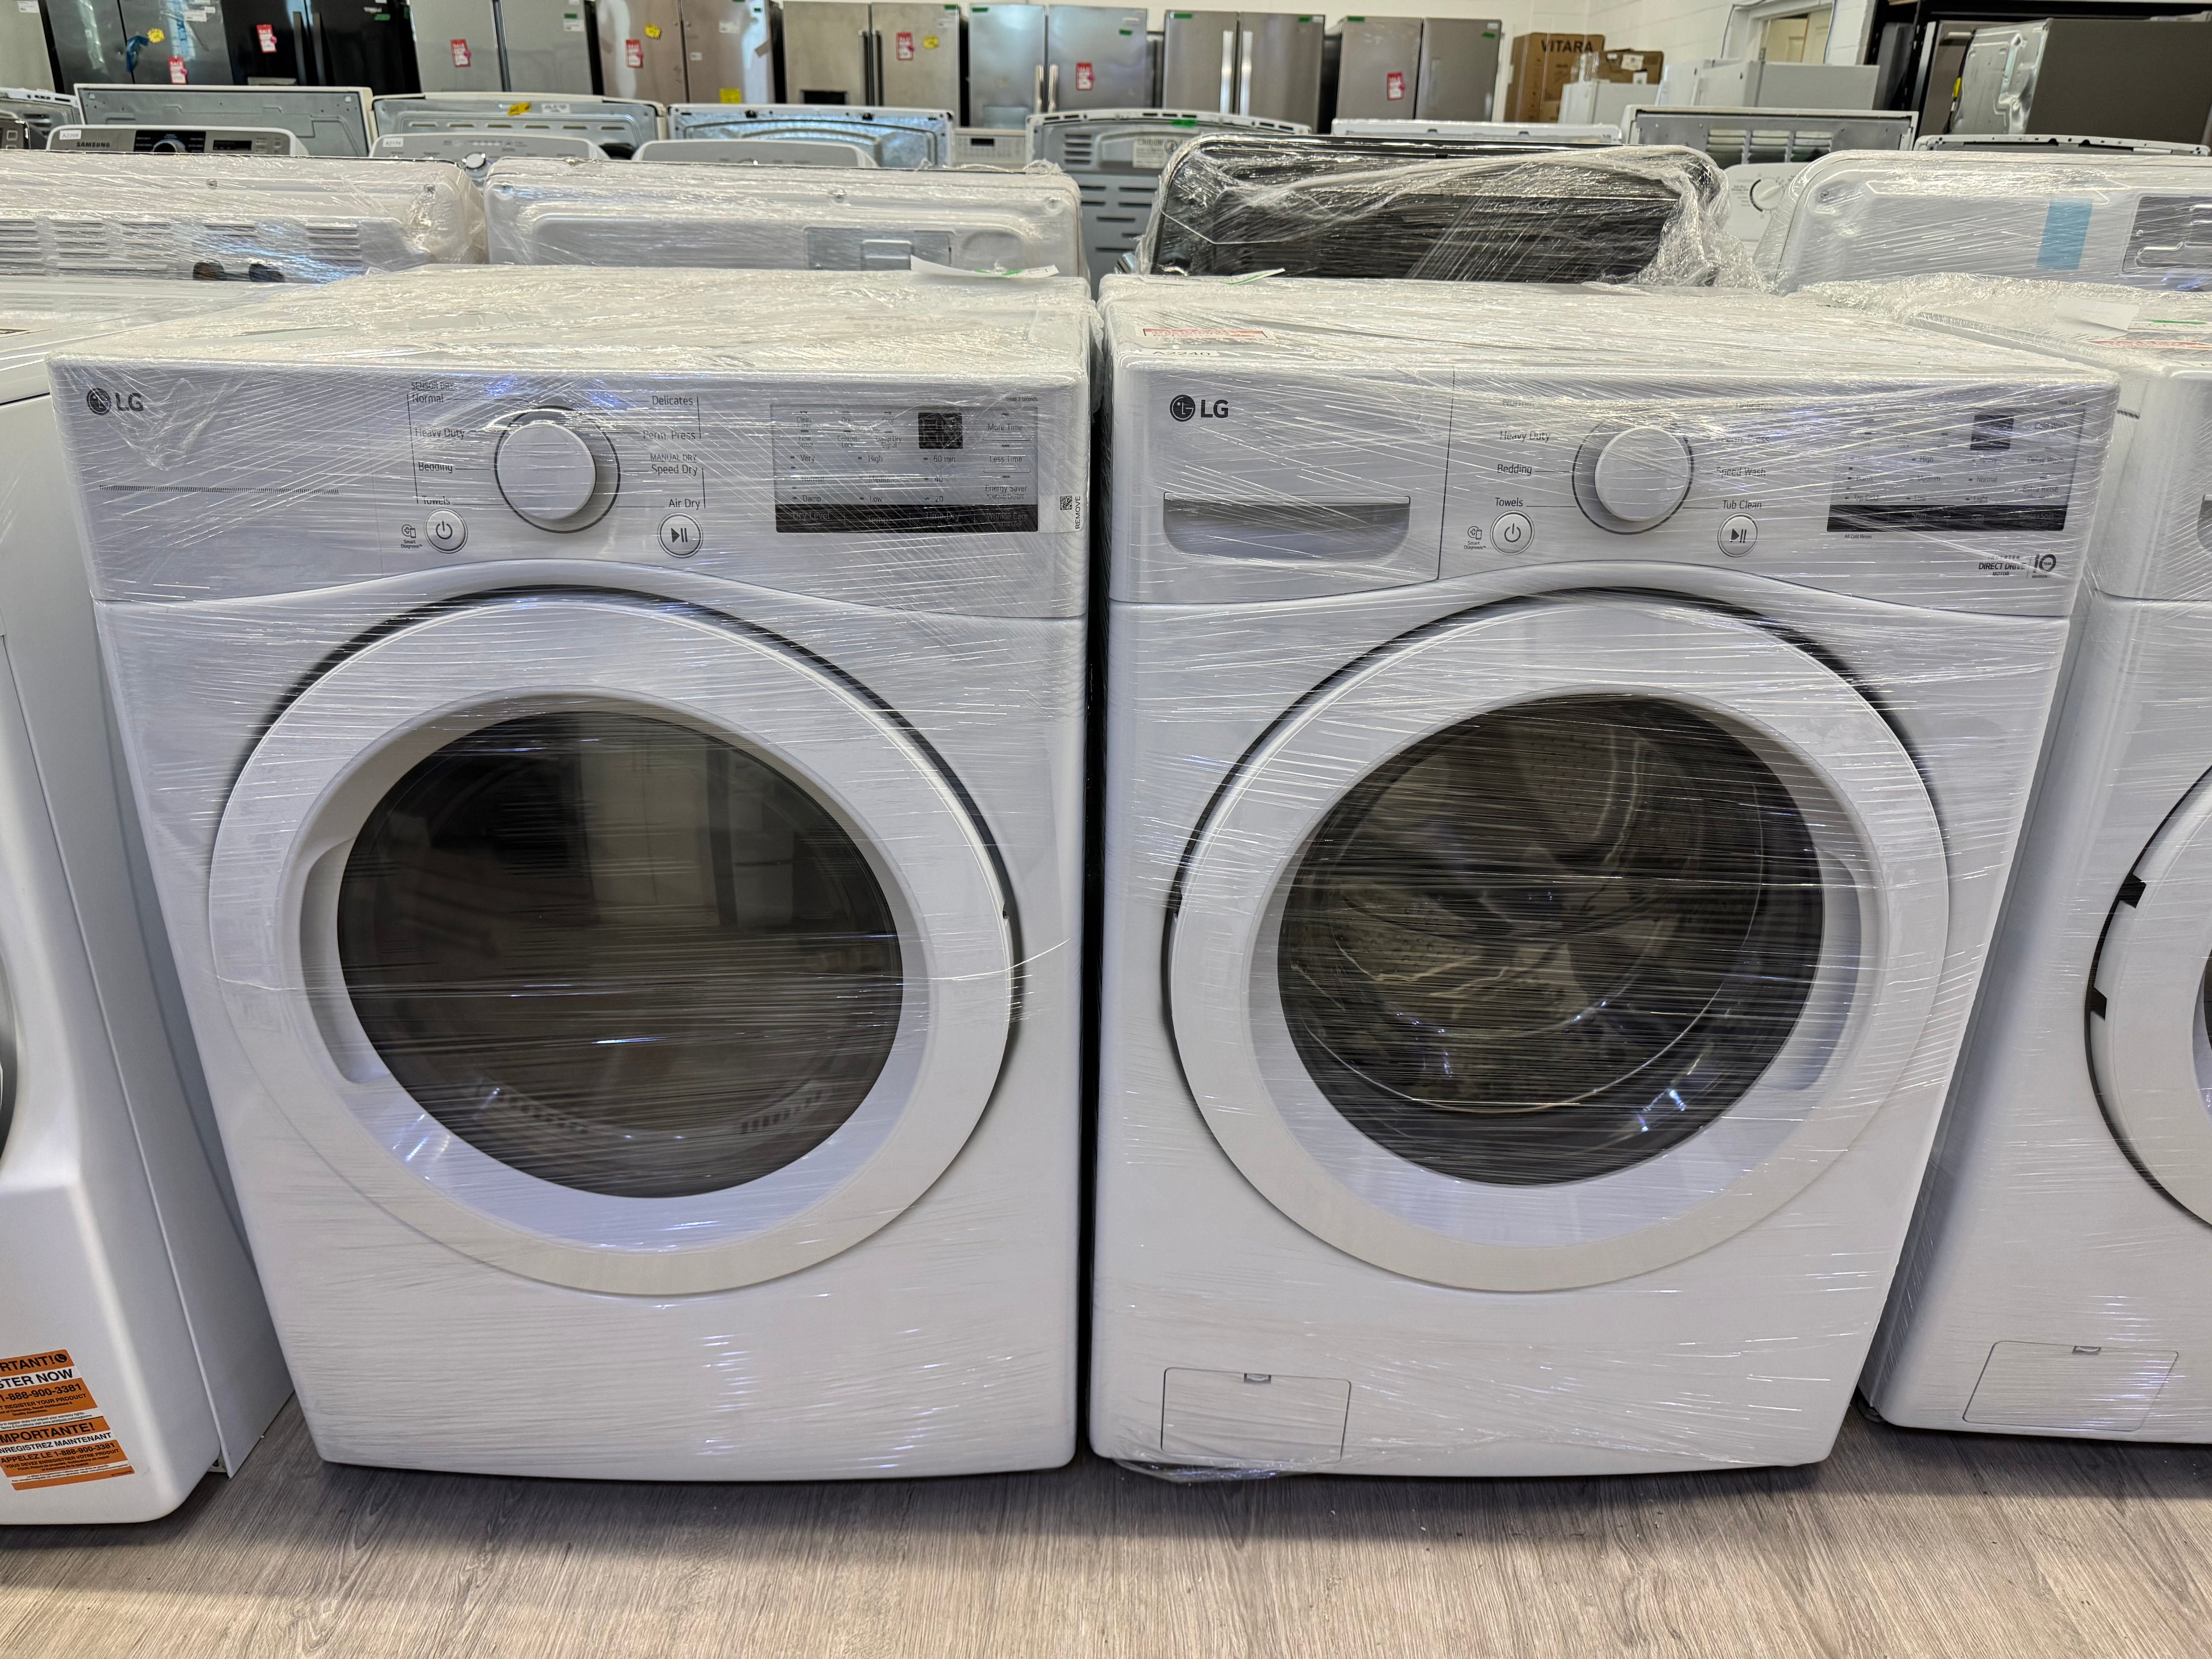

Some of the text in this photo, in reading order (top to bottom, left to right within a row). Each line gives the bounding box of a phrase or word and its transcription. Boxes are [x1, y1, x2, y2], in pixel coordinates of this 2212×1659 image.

[1541, 40, 1592, 52] VITARA
[115, 393, 143, 411] LG
[412, 393, 444, 403] Normal
[652, 395, 694, 406] Delicates
[1200, 399, 1229, 418] LG
[415, 428, 465, 440] Heavy Duty
[671, 430, 696, 440] Press
[1500, 431, 1551, 443] Heavy Duty
[800, 454, 816, 463] Very
[868, 454, 883, 464] High
[990, 455, 1023, 463] Less Time
[419, 462, 453, 474] Bedding
[652, 464, 698, 476] Speed Dry
[1498, 464, 1532, 476] Bedding
[1717, 467, 1766, 478] Speed Wash
[985, 485, 1008, 494] Energy
[421, 495, 450, 505] Towels
[669, 498, 700, 510] Air Dry
[802, 495, 821, 503] Damp
[1495, 497, 1524, 507] Towels
[1723, 500, 1762, 509] Tub Clean
[1912, 512, 1926, 521] Spin
[1978, 562, 2027, 570] DIRECT DRIVE
[36, 1369, 73, 1383] NOW
[0, 1383, 82, 1402] 1-888-900-3381
[5, 1402, 36, 1410] REGISTER
[36, 1398, 55, 1406] YOUR
[56, 1393, 87, 1403] PRODUCT
[54, 1432, 112, 1446] MAINTENANT
[1, 1453, 40, 1463] APPELEZ
[54, 1442, 115, 1456] 1-888-900-3381
[39, 1456, 76, 1464] ENREGISTRER
[96, 1449, 120, 1457] PRODUIT
